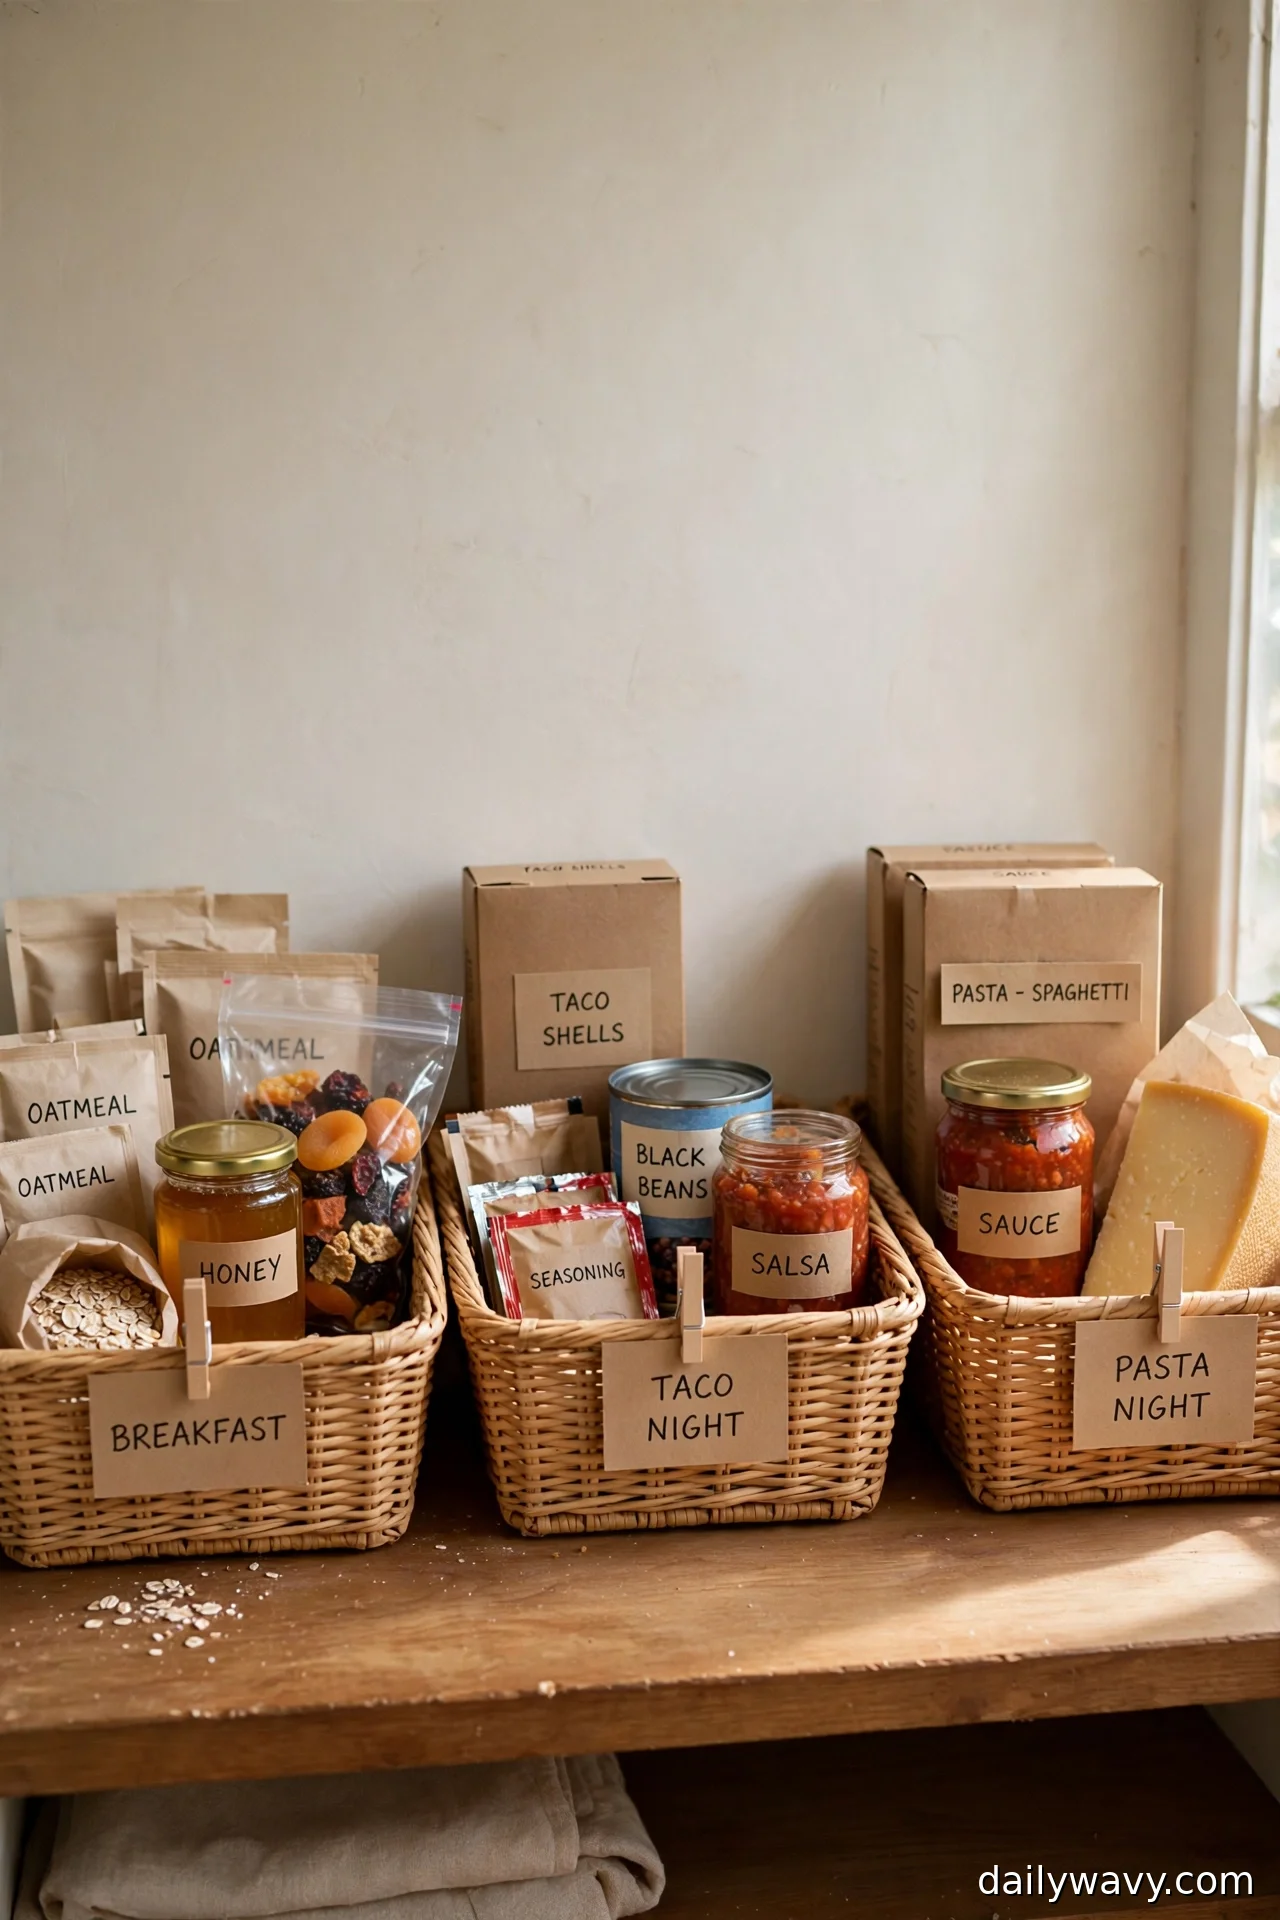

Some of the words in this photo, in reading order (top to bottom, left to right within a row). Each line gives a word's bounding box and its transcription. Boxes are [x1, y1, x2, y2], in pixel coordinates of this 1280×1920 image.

[549, 991, 610, 1012] TACO
[953, 983, 1008, 1003] PASTA
[1032, 983, 1129, 1002] SPAGHETTI
[543, 1022, 624, 1046] SHELLS
[28, 1094, 137, 1124] OATMEAL
[636, 1143, 705, 1168] BLACK
[18, 1165, 115, 1197] OATMEAL
[638, 1178, 708, 1199] BEANS
[979, 1212, 1060, 1236] SAUCE
[200, 1254, 282, 1285] HONEY
[530, 1261, 626, 1289] SEASONING
[752, 1253, 830, 1277] SALSA
[1116, 1352, 1210, 1382] PASTA
[651, 1373, 734, 1400] TACO
[1113, 1392, 1211, 1421] NIGHT
[111, 1414, 287, 1452] BREAKFAST
[648, 1411, 744, 1442] NIGHT
